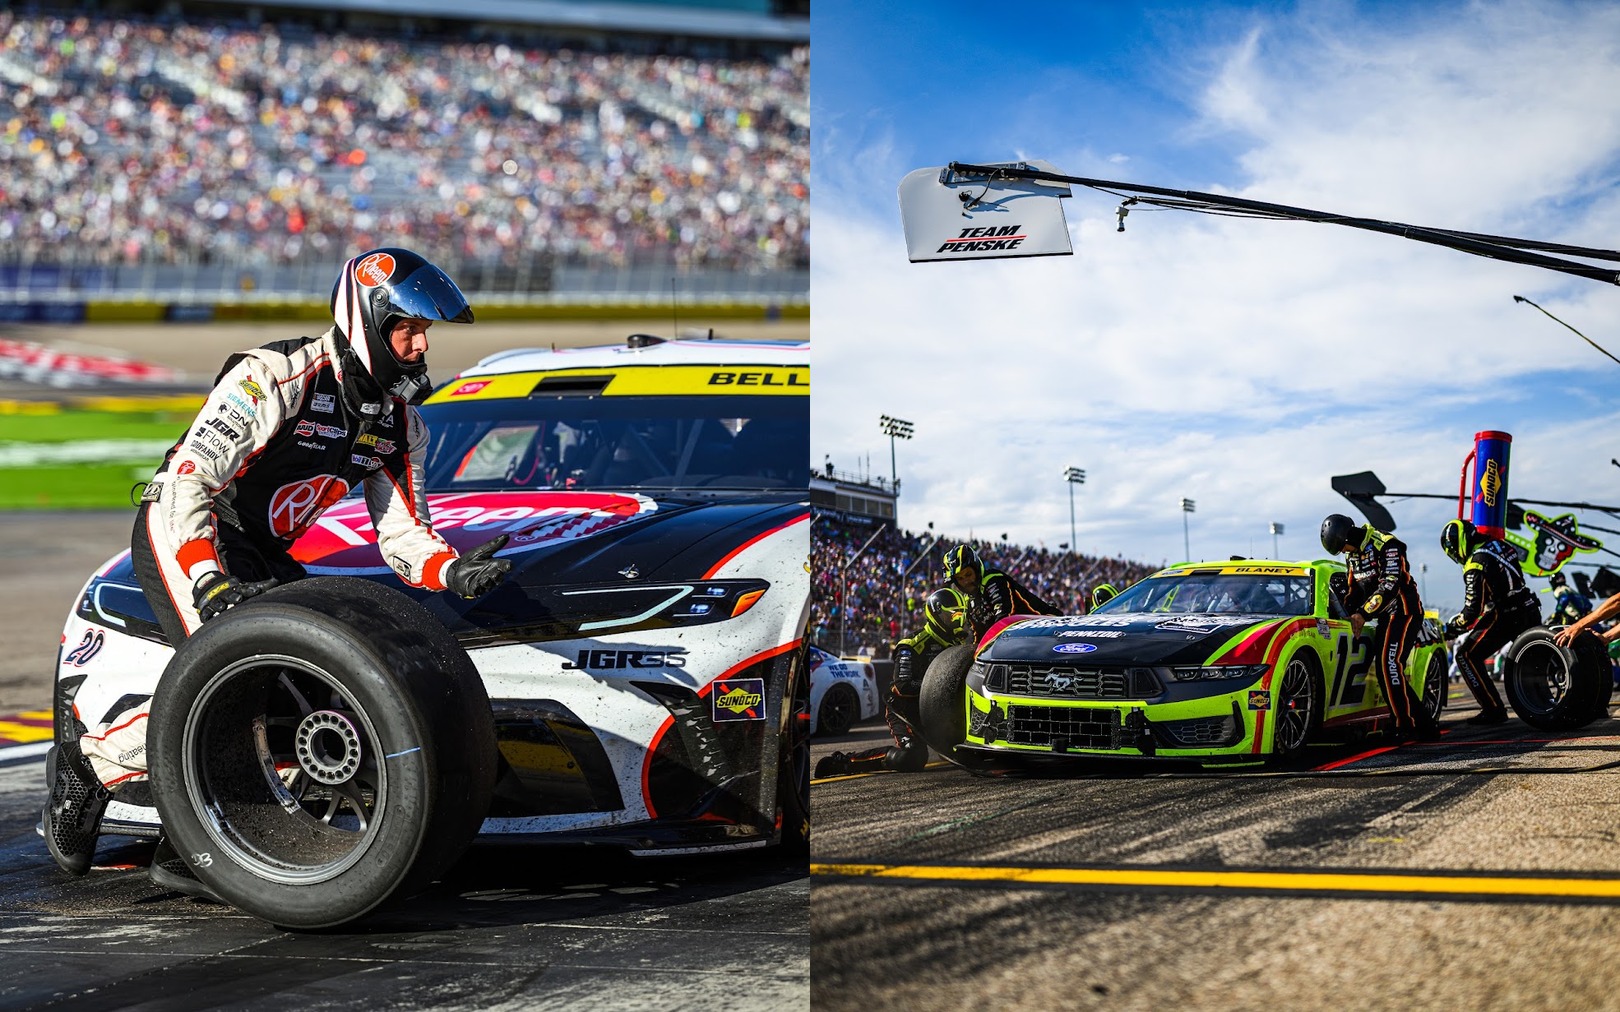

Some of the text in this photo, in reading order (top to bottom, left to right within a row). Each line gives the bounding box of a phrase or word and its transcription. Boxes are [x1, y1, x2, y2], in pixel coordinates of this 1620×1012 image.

[958, 225, 1021, 238] TEAM
[936, 238, 1024, 253] PENSKE
[357, 254, 390, 285] Rheem
[239, 379, 267, 402] SUNOCO
[708, 372, 810, 386] BELL
[227, 393, 257, 418] SIEMENS
[230, 408, 249, 427] DN
[205, 417, 241, 442] JGR
[1485, 460, 1498, 506] SUNOCO
[63, 628, 106, 667] 20
[1328, 632, 1374, 710] 12
[1389, 642, 1400, 686] DURACELL
[717, 695, 760, 708] SUNOCO
